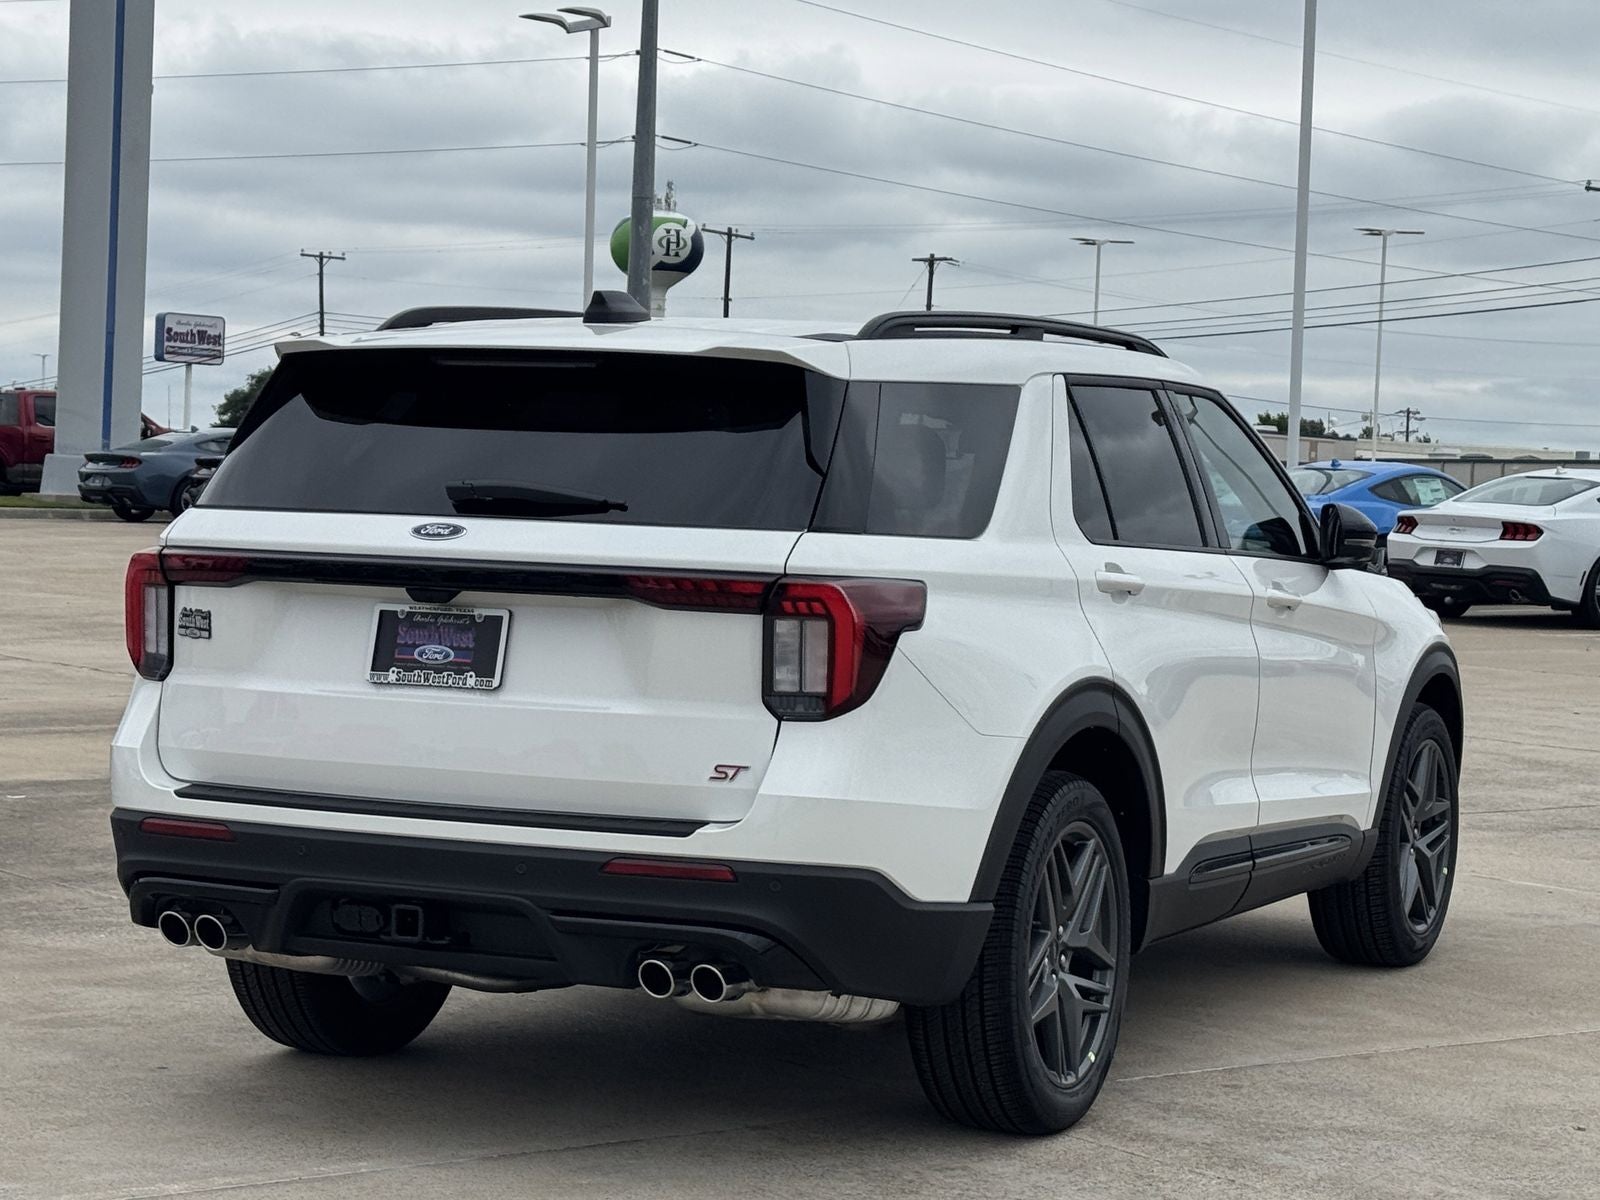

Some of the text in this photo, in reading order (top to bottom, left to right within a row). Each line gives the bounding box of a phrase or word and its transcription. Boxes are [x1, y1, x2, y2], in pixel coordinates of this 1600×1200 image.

[421, 524, 454, 535] Ford
[422, 648, 445, 660] Ford
[709, 764, 751, 782] ST
